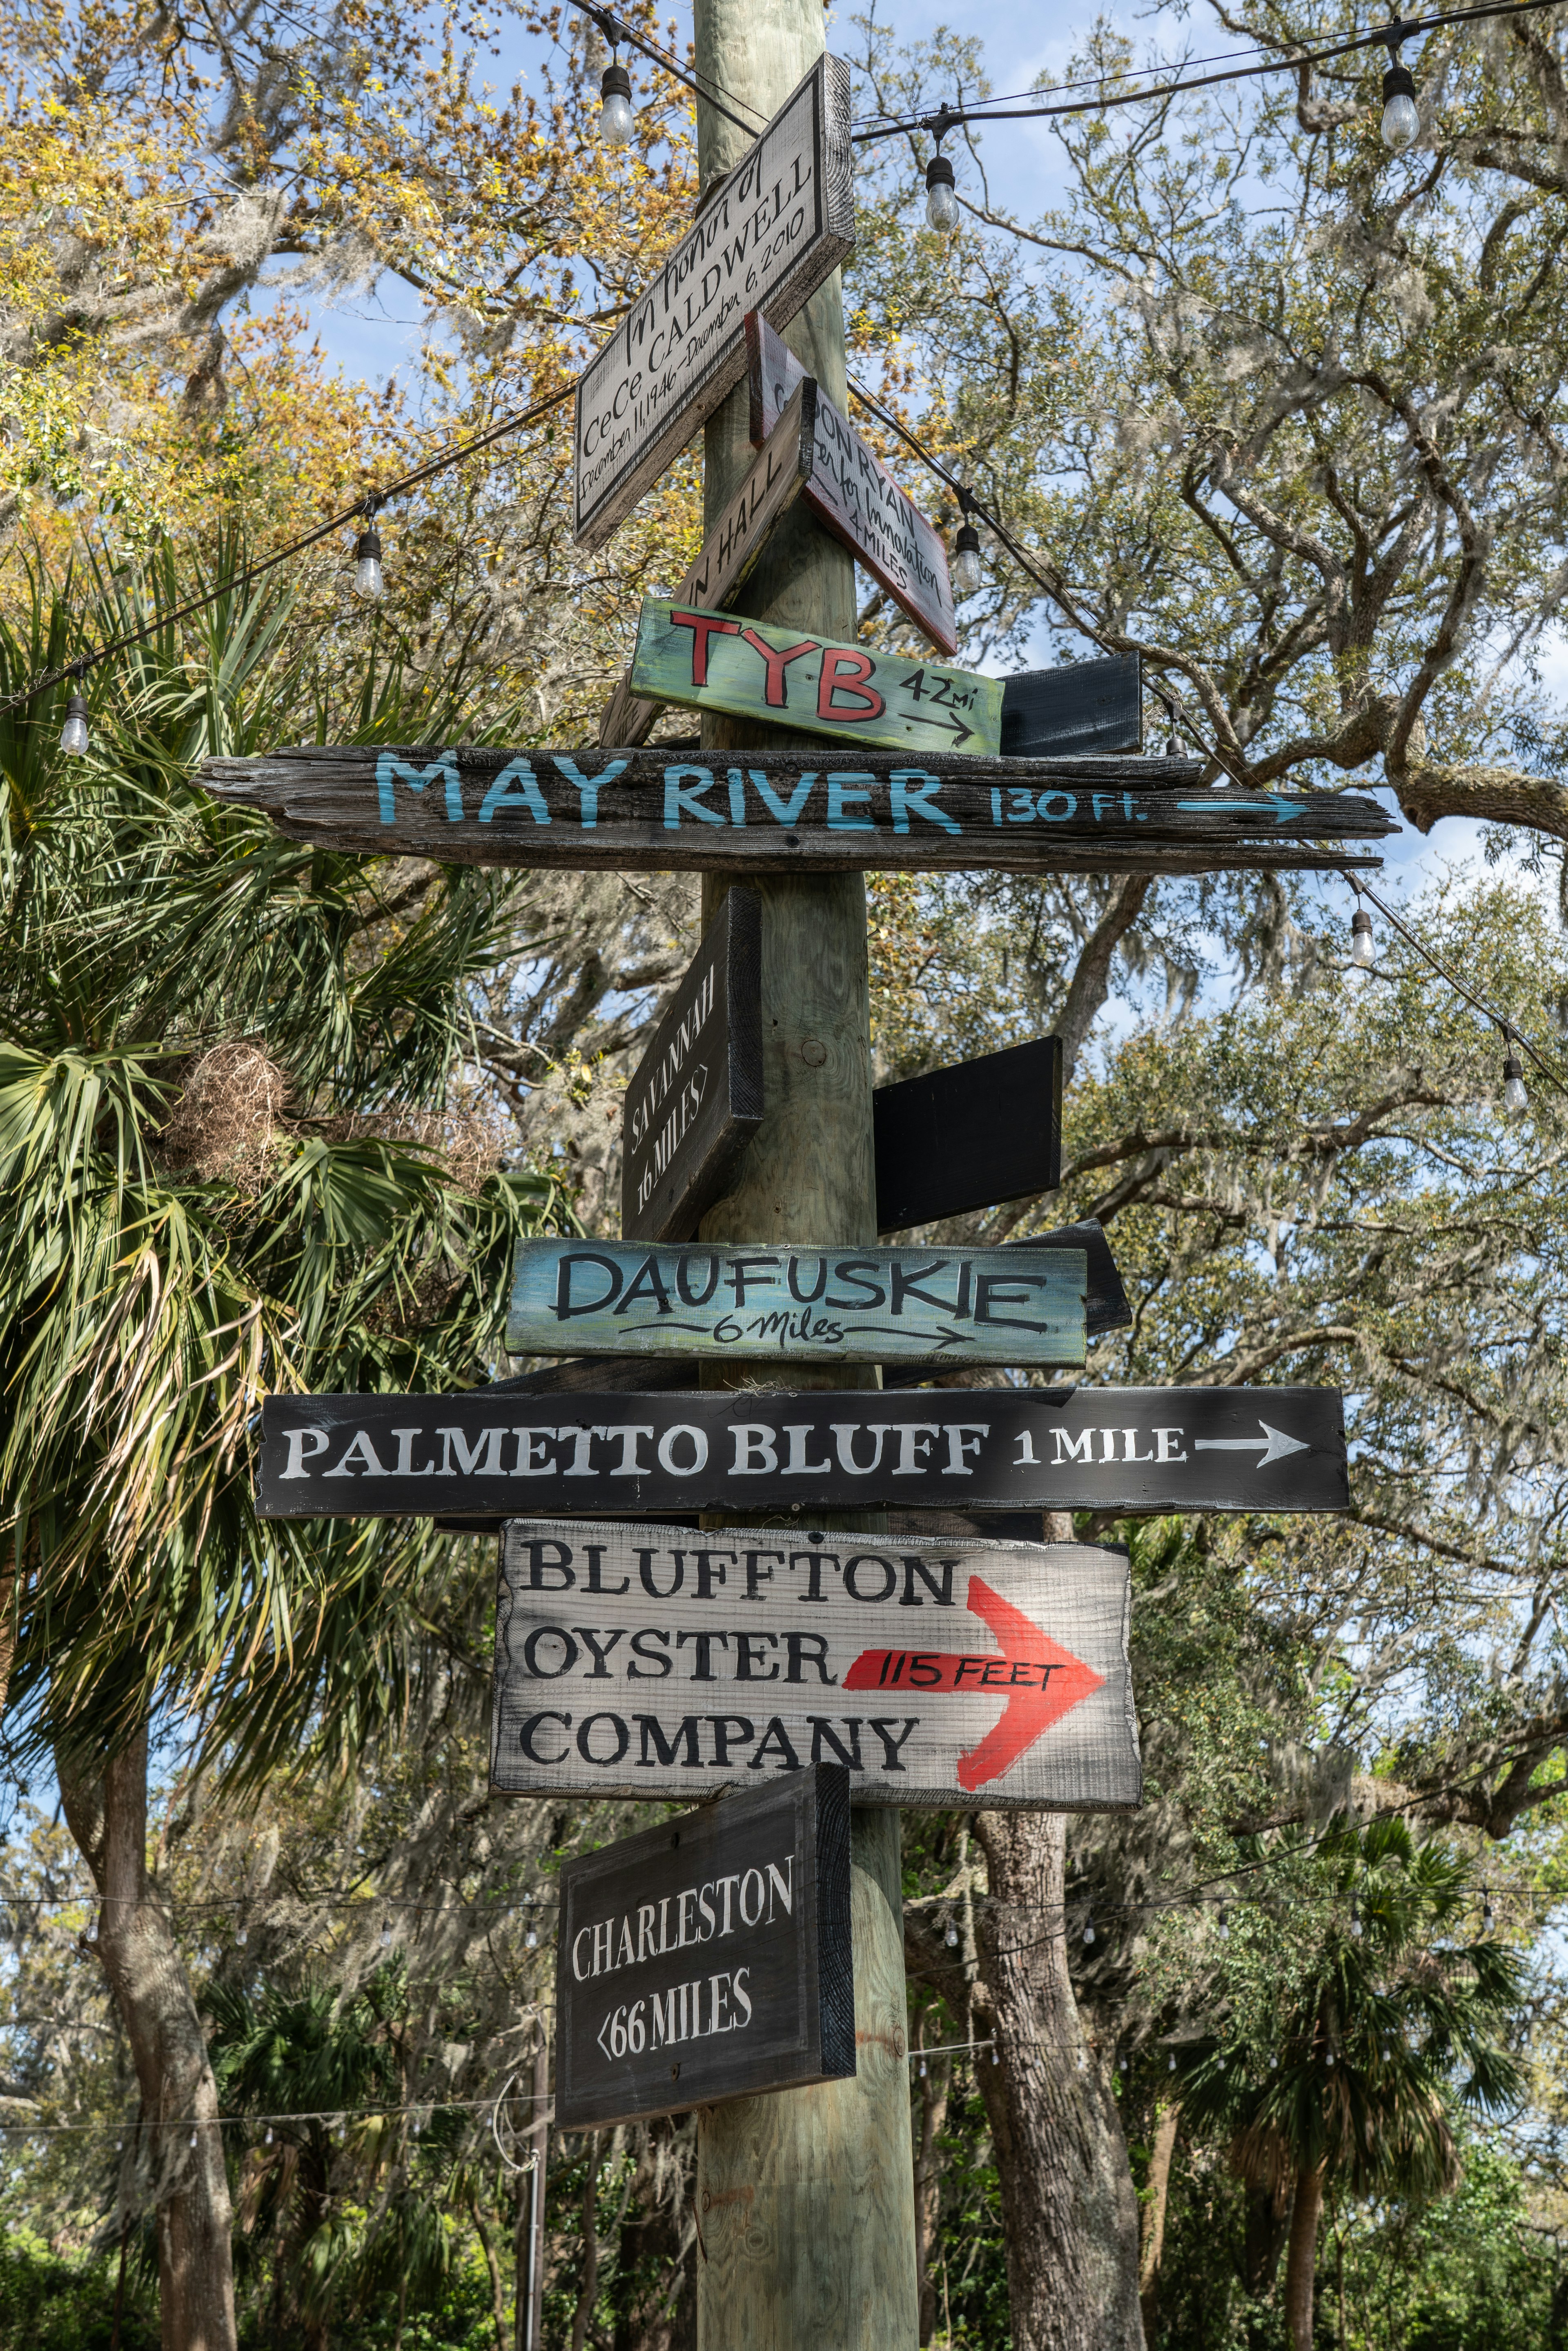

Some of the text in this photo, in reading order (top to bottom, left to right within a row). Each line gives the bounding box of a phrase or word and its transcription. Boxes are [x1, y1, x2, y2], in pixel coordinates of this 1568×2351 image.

[627, 136, 764, 367] In honor of
[584, 153, 812, 457] CeCe CALDWELL
[580, 428, 630, 501] December
[761, 207, 804, 274] 2010
[717, 451, 782, 575] HALL
[840, 455, 861, 510] for
[858, 444, 915, 539] RYAN
[849, 509, 907, 590] 4 MILES
[670, 610, 886, 723] TYB
[375, 750, 632, 829] MAY
[663, 764, 962, 835] RIVER
[990, 787, 1078, 826] 130
[630, 961, 715, 1156] SAVANNAH
[637, 1160, 652, 1215] 16
[548, 1253, 1047, 1334] DAUFUSKIE
[713, 1306, 844, 1348] 6 Miles
[278, 1424, 1189, 1479] PALMETTO BLUFF 1 MILE
[519, 1539, 960, 1607] BLUFFTON
[524, 1626, 838, 1686] OYSTER
[878, 1652, 1066, 1691] 115 FEET
[519, 1711, 920, 1772] COMPANY
[572, 1855, 795, 1982] CHARLESTON
[649, 1967, 752, 2051] MILES
